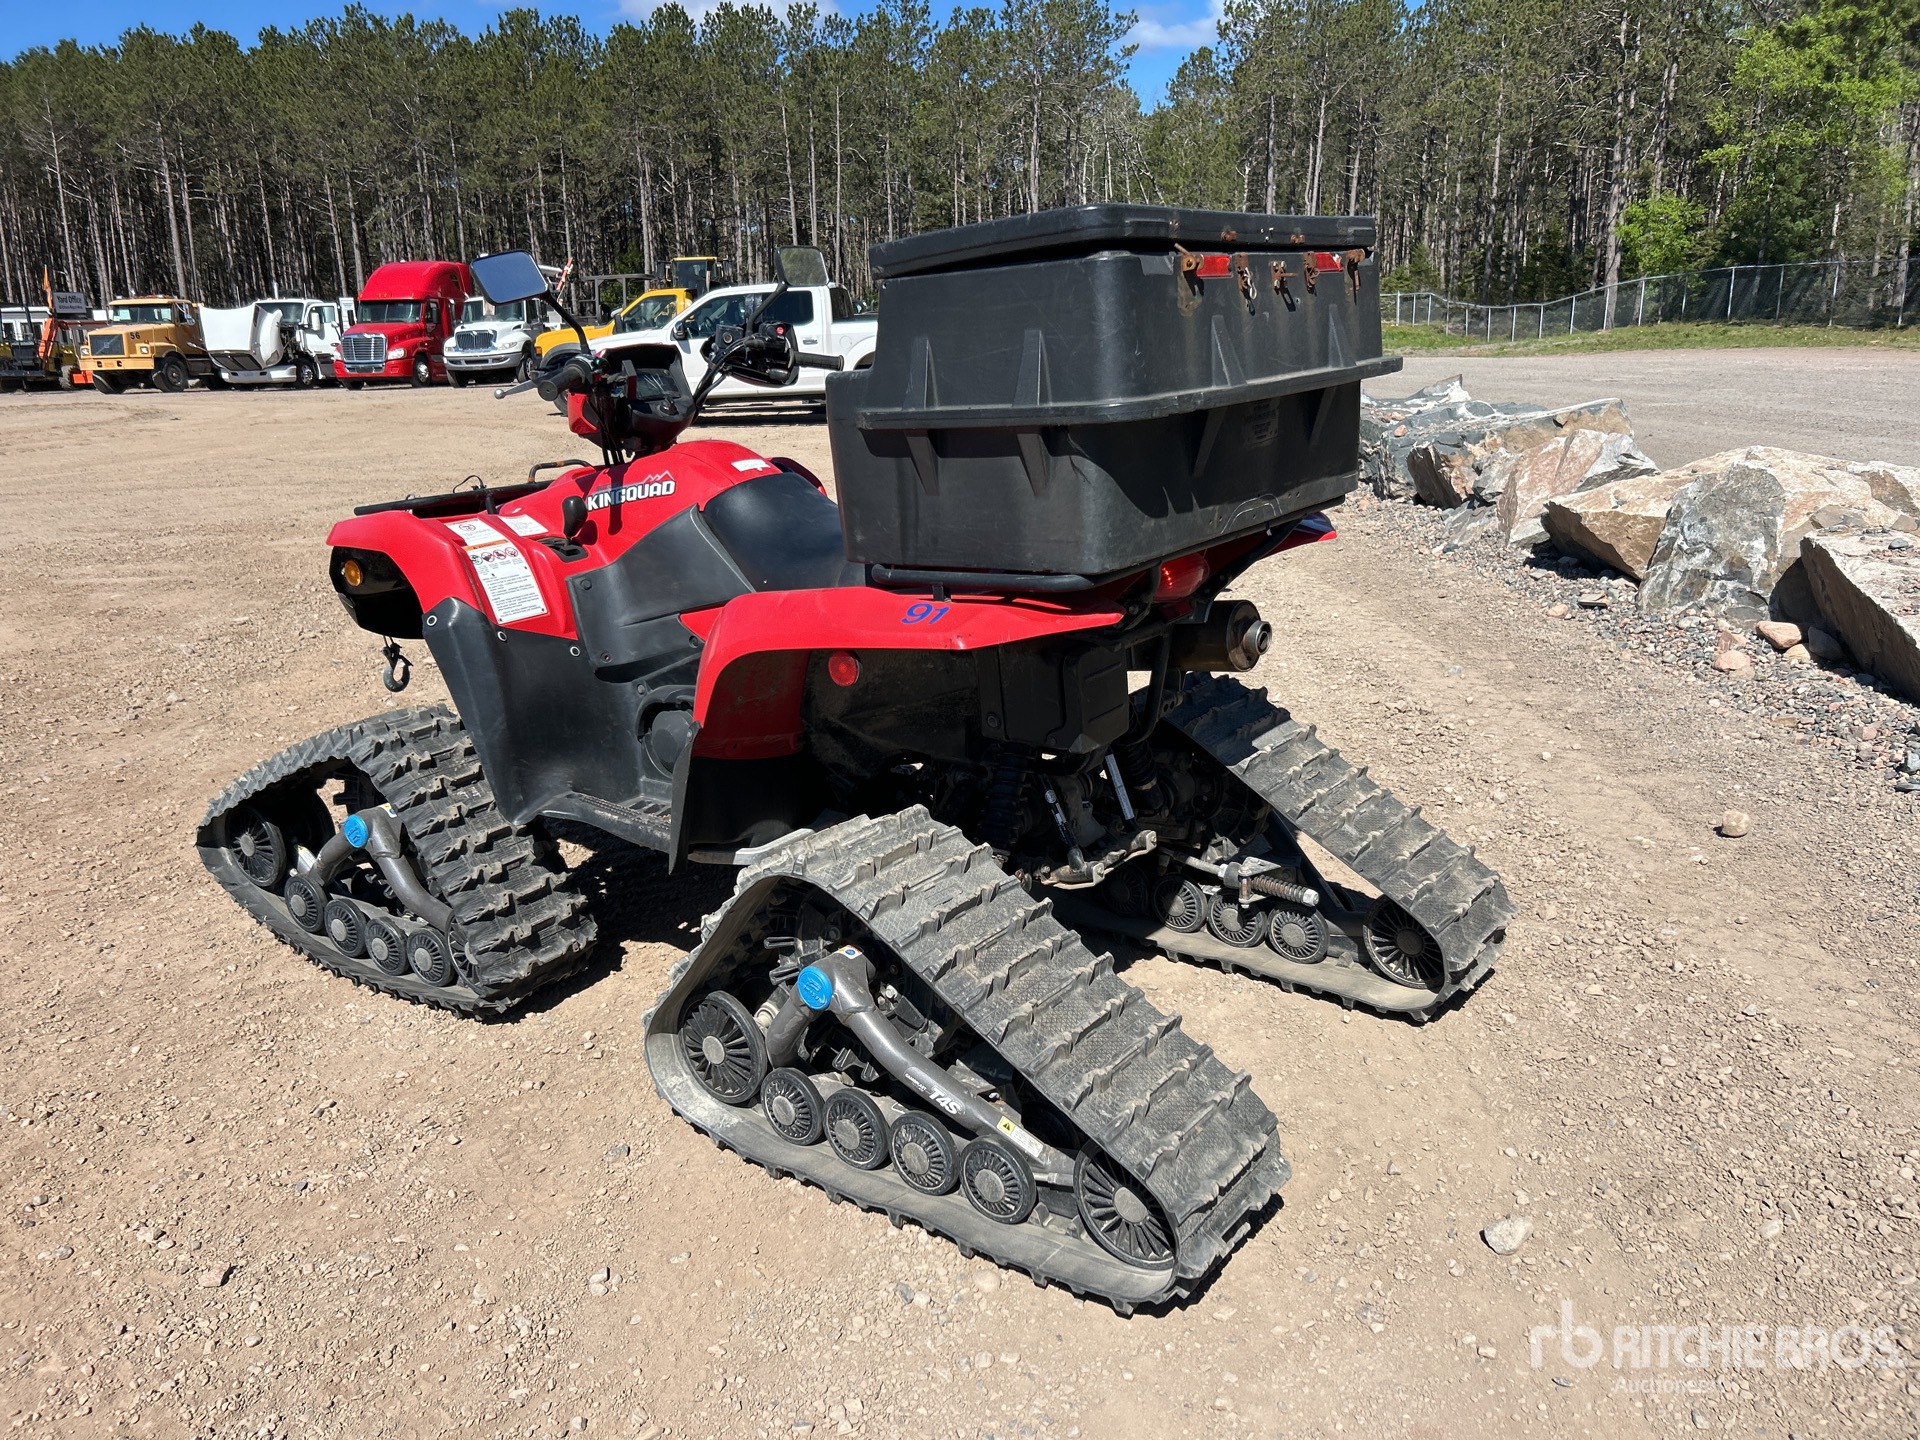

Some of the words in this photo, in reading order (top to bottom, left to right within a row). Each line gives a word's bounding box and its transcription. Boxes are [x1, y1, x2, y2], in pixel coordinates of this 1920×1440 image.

[56, 295, 68, 304] Yard
[68, 295, 82, 304] Office
[129, 332, 141, 340] 56
[587, 480, 676, 511] KINGQUAD
[901, 603, 950, 624] 91
[929, 1087, 961, 1115] T4S
